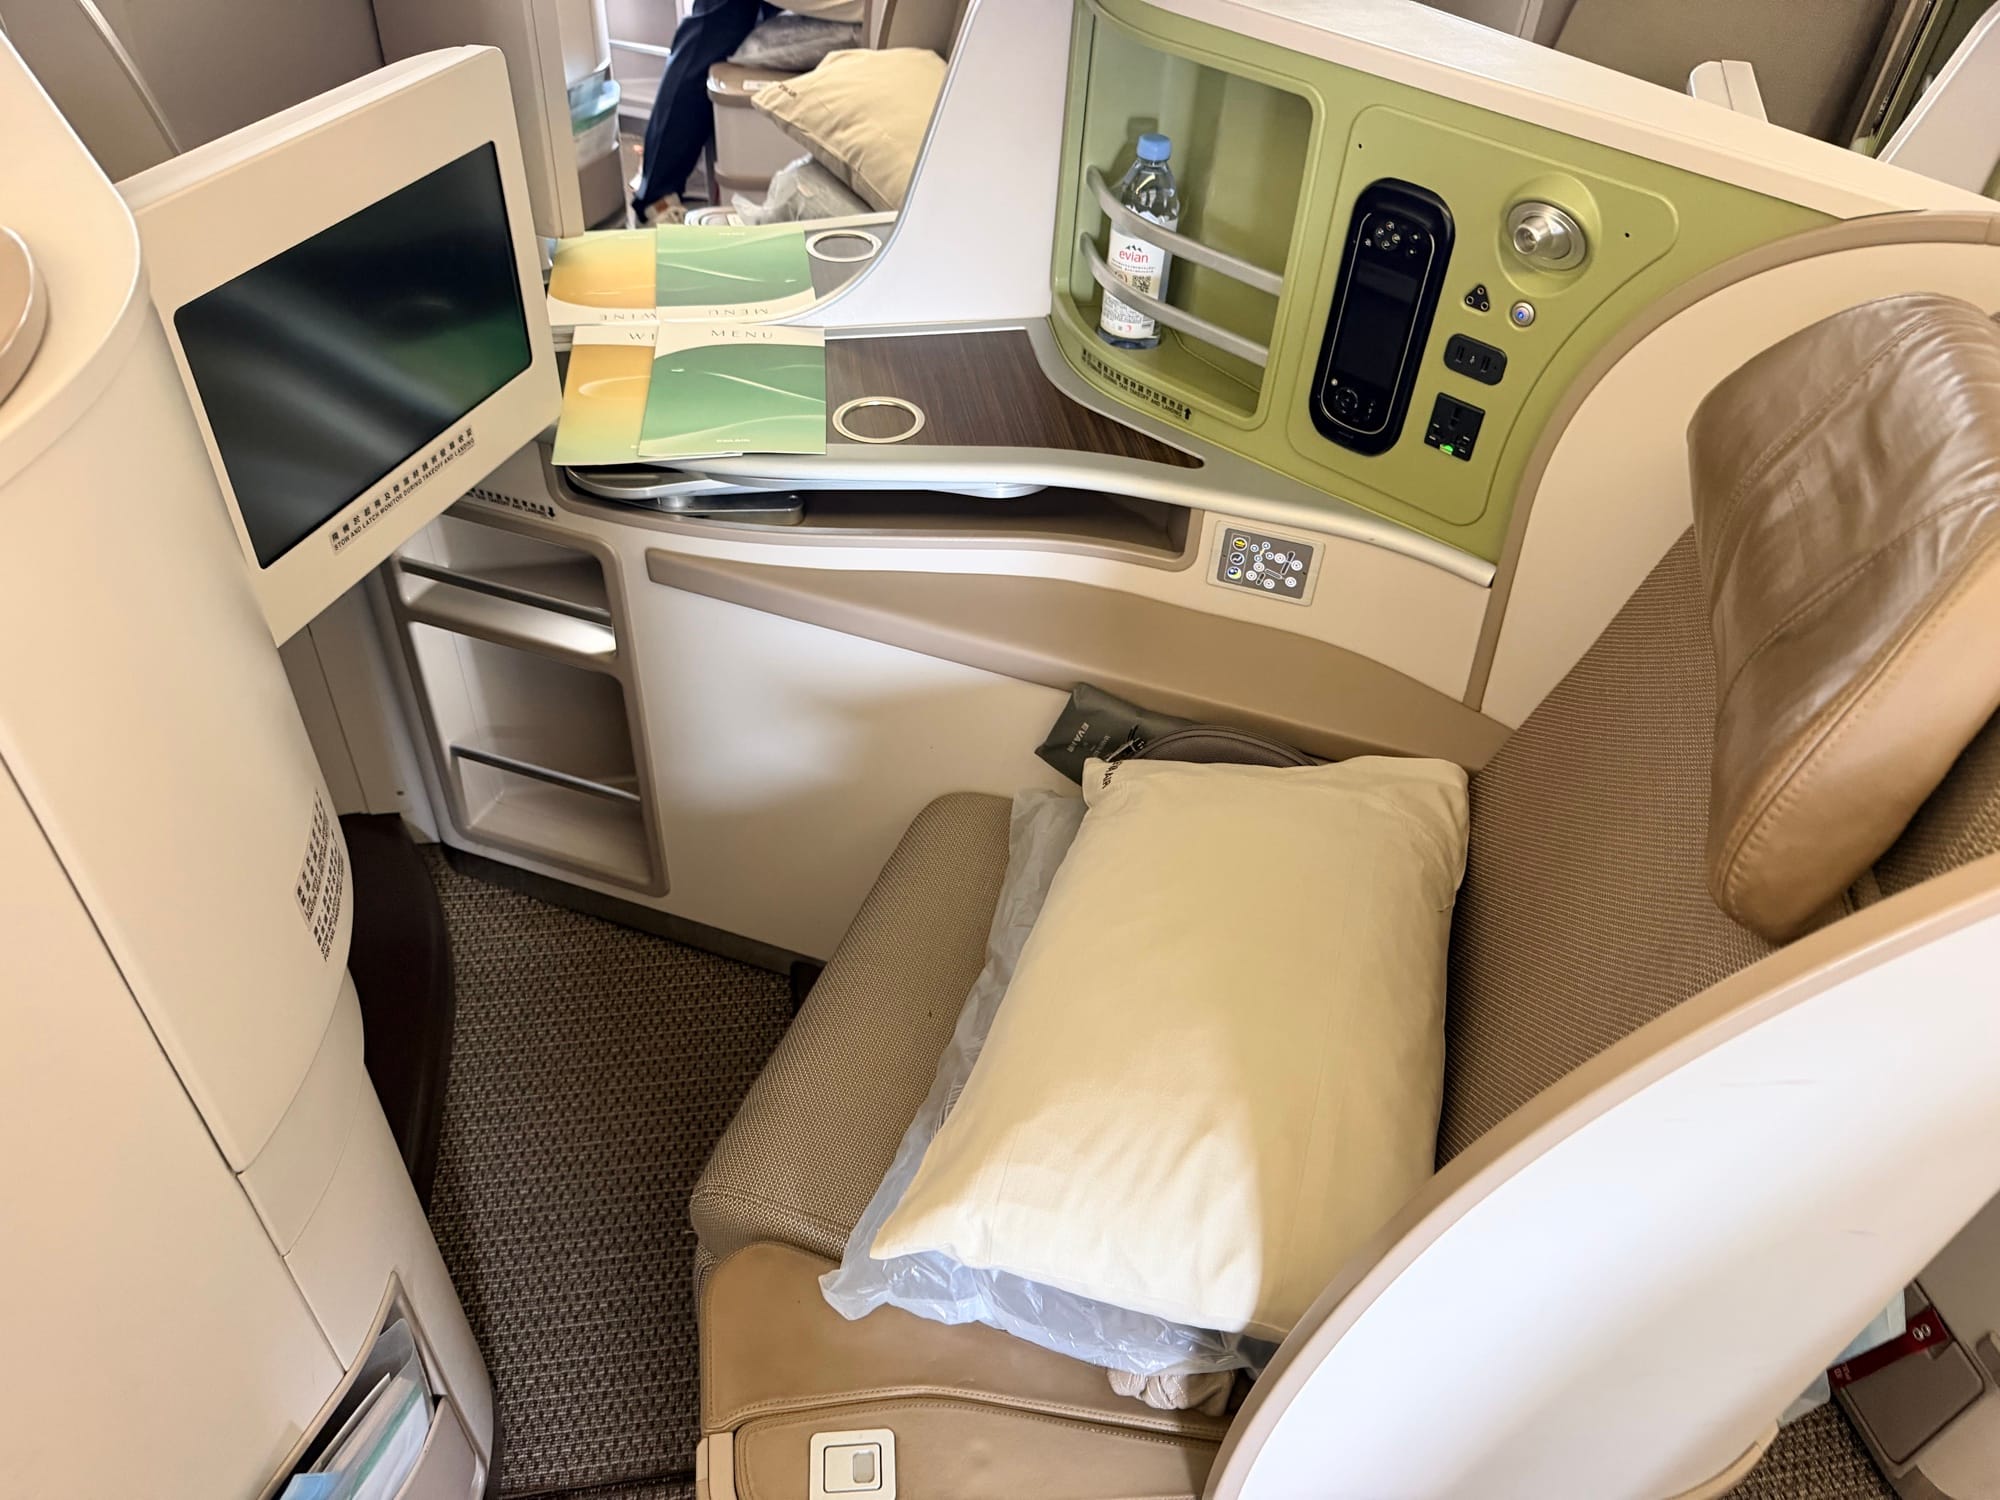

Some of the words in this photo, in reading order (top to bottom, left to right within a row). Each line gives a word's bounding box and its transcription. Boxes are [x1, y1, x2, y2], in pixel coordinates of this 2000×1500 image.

[1119, 250, 1149, 263] evian
[708, 308, 768, 316] MENU
[629, 331, 656, 340] WI
[711, 329, 773, 338] MENU
[334, 536, 351, 551] STOW
[351, 526, 362, 538] AND
[362, 512, 379, 529] LATCH
[380, 492, 402, 515] MONITOR
[403, 478, 423, 497] DURING
[423, 462, 444, 481] TAKEOFF
[444, 453, 454, 465] AND
[454, 437, 475, 455] LANDING
